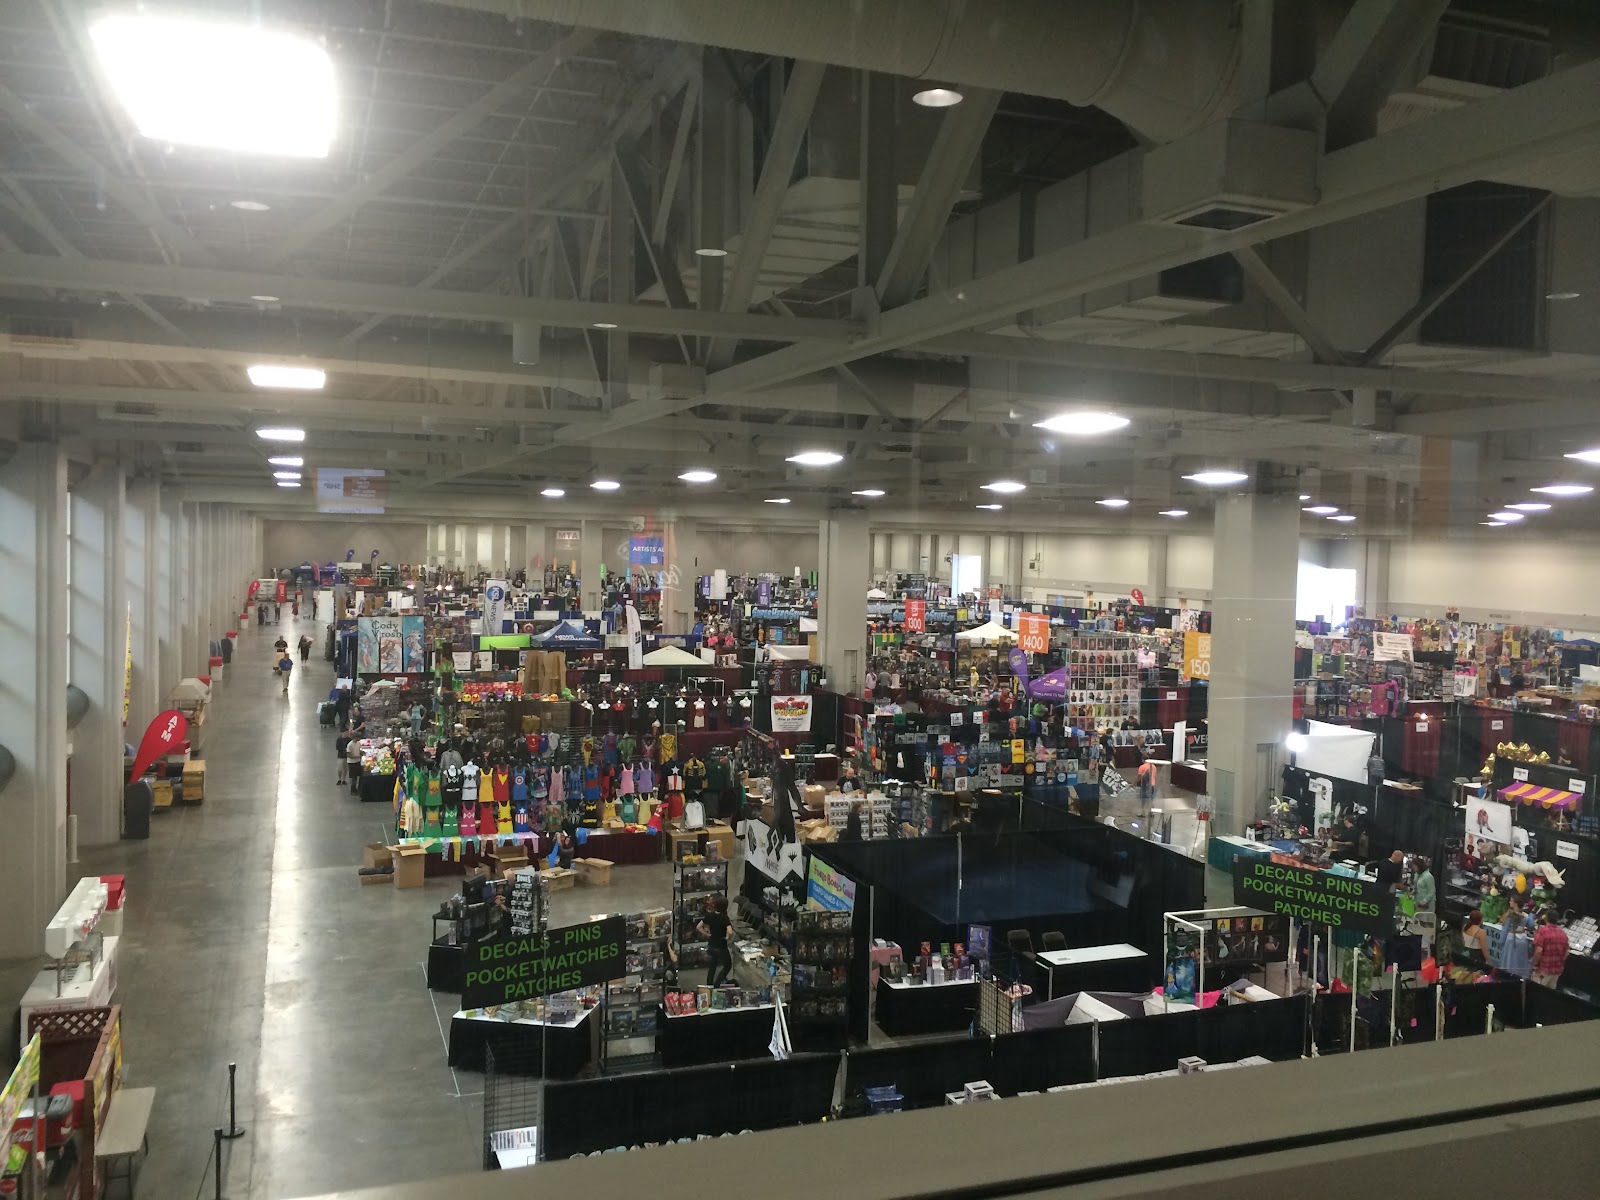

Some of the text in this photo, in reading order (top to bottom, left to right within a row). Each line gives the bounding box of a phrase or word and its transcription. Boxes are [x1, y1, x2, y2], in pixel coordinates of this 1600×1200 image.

[908, 618, 922, 630] 1300
[1022, 634, 1044, 650] 1400
[160, 715, 178, 742] ATM
[1254, 864, 1314, 886] DECALS
[1326, 877, 1363, 896] PINS
[1243, 877, 1380, 917] POCKETWATCHES
[1274, 901, 1342, 926] PATCHES
[479, 935, 550, 961] DECALS
[564, 924, 602, 946] PINS
[466, 942, 619, 988] POCKETWATCHES
[504, 969, 582, 1000] PATCHES
